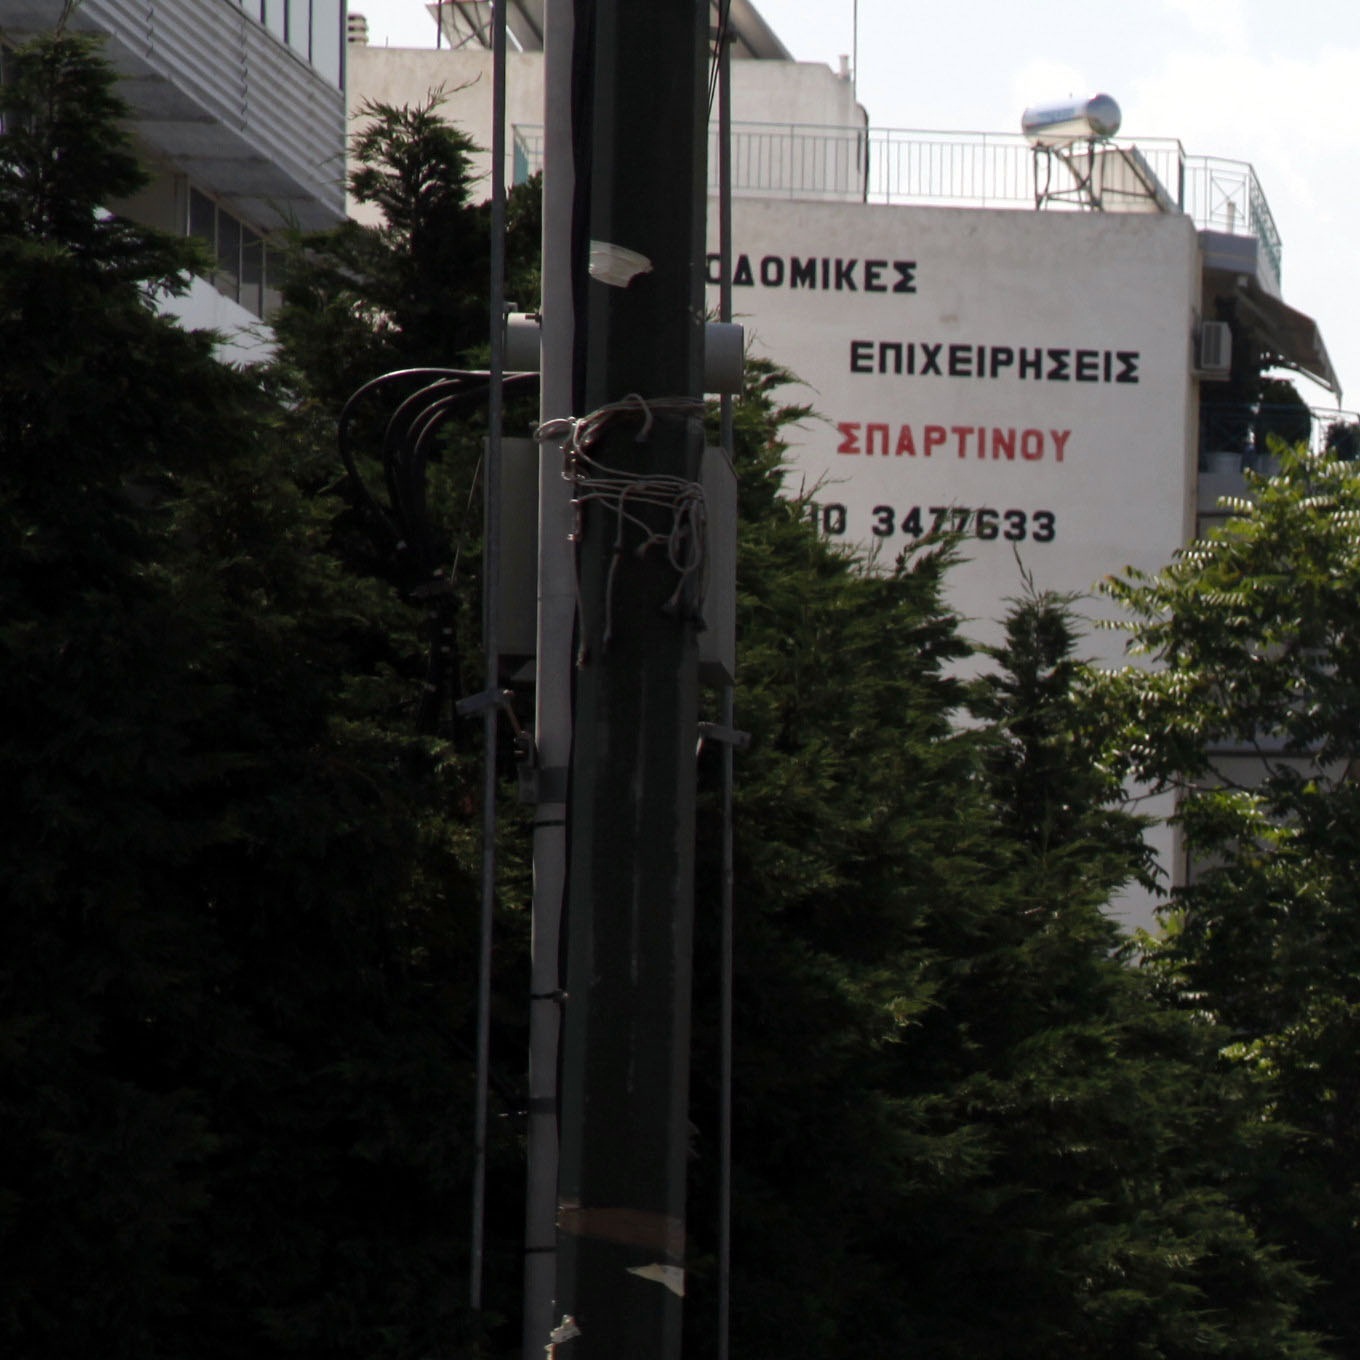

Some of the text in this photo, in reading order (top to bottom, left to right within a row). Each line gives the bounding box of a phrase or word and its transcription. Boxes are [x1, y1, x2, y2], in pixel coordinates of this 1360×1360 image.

[849, 340, 1140, 383] ΕΠΙΧΕΙΡΗΣΕΙΣ
[836, 421, 1072, 463] ΣΠΑΡΤΙΝΟΥ
[871, 504, 1056, 542] 3477633
